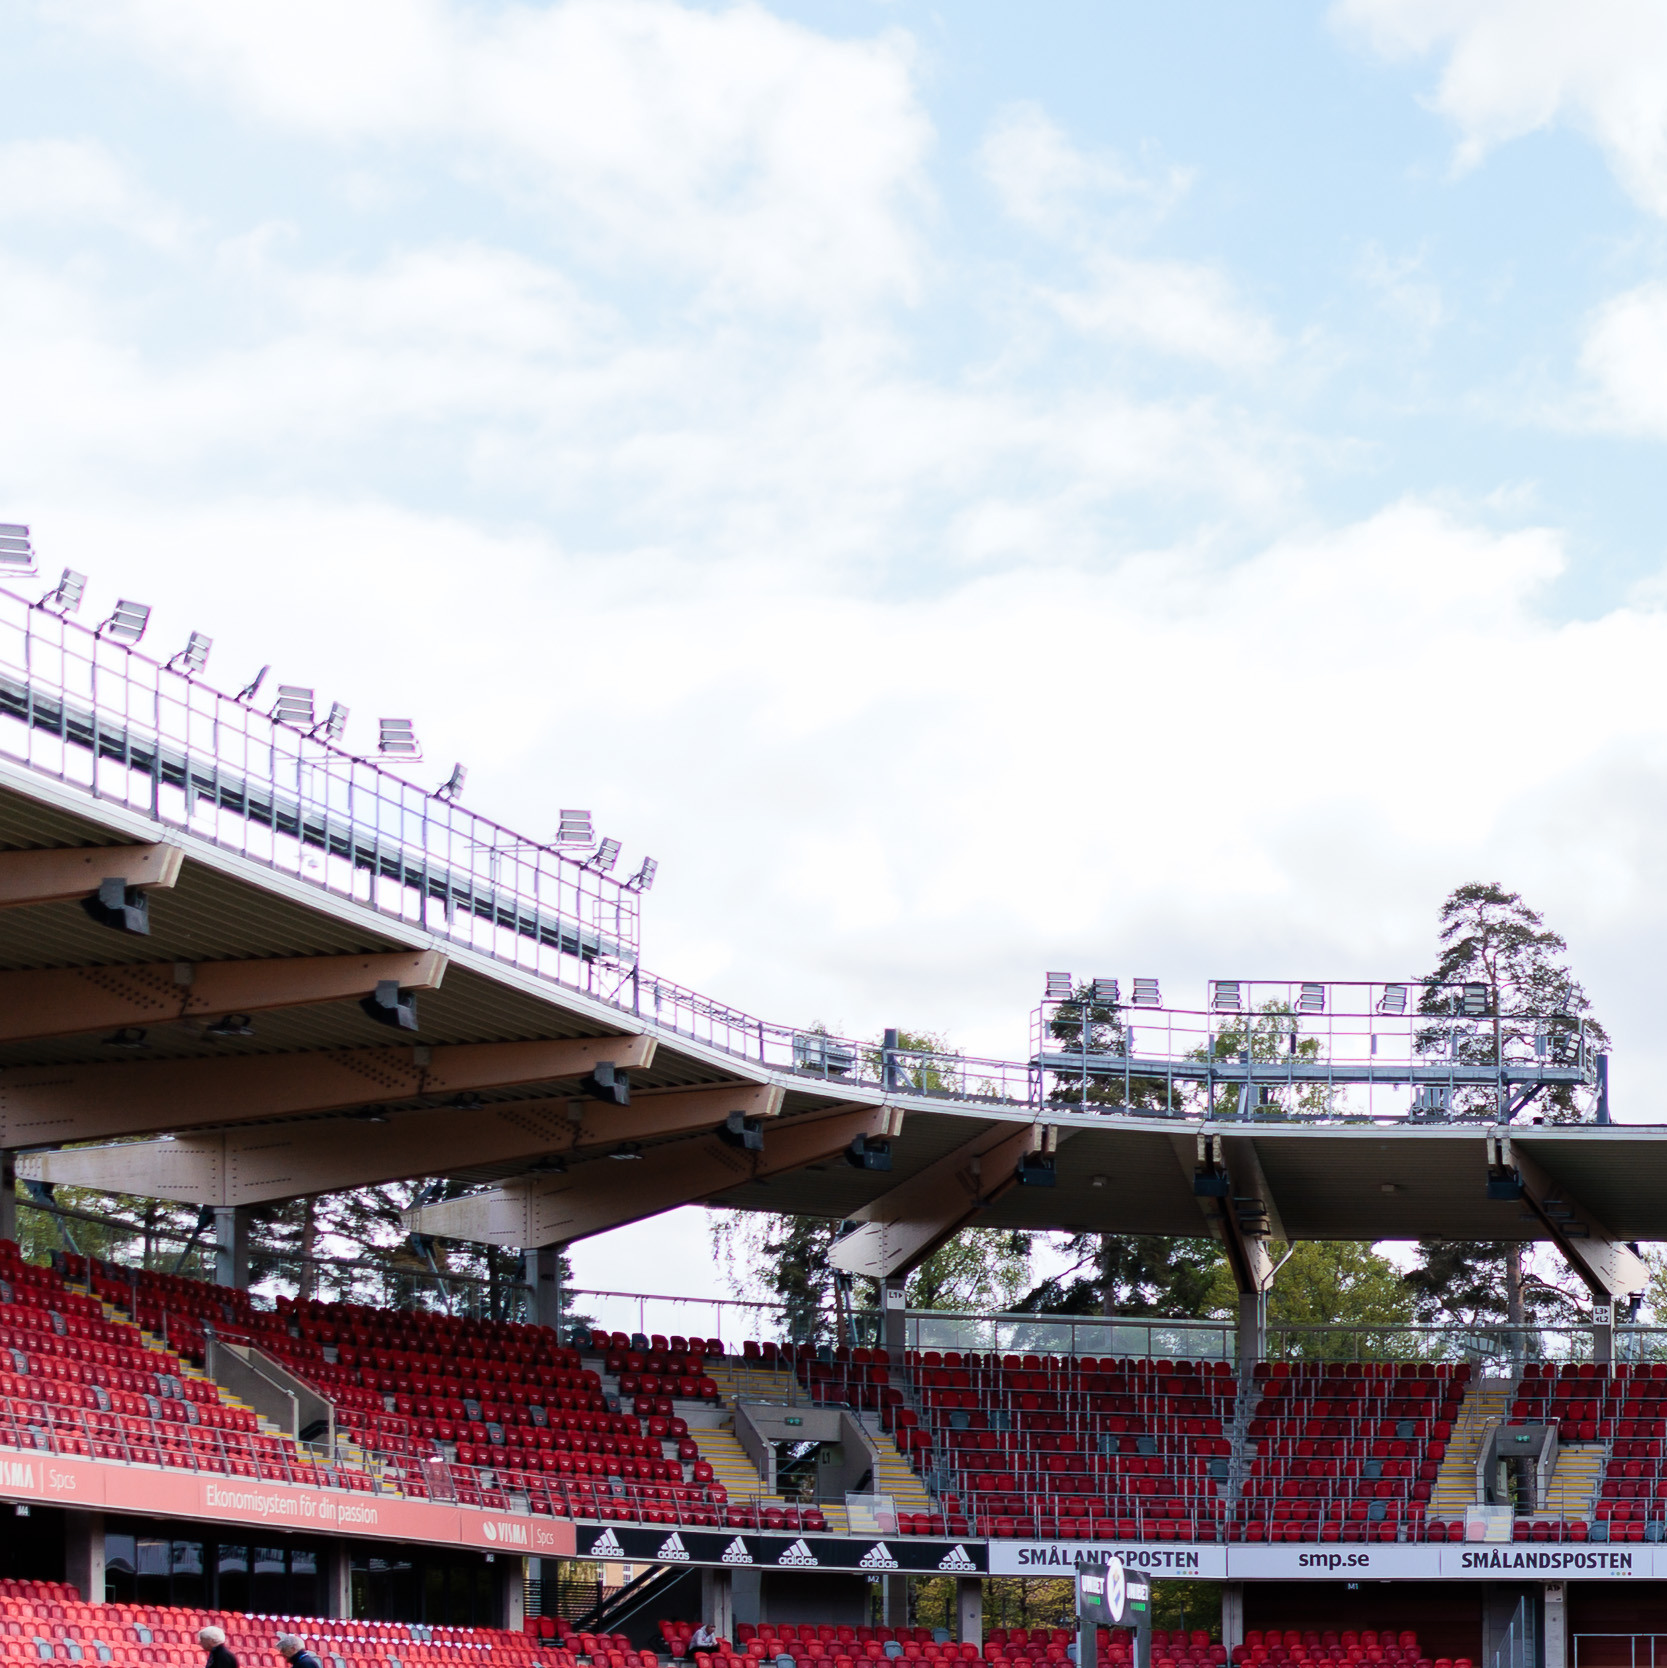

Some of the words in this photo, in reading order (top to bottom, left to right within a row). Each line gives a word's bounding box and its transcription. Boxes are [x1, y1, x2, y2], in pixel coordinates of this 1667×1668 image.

[1595, 1307, 1604, 1315] L3
[0, 1461, 34, 1489] ISMA
[49, 1469, 76, 1491] Spcs
[206, 1484, 297, 1517] Ekonomisystem
[300, 1495, 317, 1517] för
[318, 1499, 336, 1520] din
[338, 1500, 378, 1525] passion
[498, 1522, 527, 1545] VISMA
[537, 1527, 554, 1546] Spcs
[591, 1544, 625, 1557] adidas
[657, 1548, 690, 1561] adidas
[721, 1551, 753, 1564] adidas
[778, 1553, 819, 1566] adidas
[859, 1556, 899, 1569] adidas
[1298, 1552, 1370, 1570] smp.se
[1461, 1548, 1632, 1569] SMÅLANDSPOSTEN
[938, 1559, 976, 1571] adidas
[867, 1575, 880, 1583] M2
